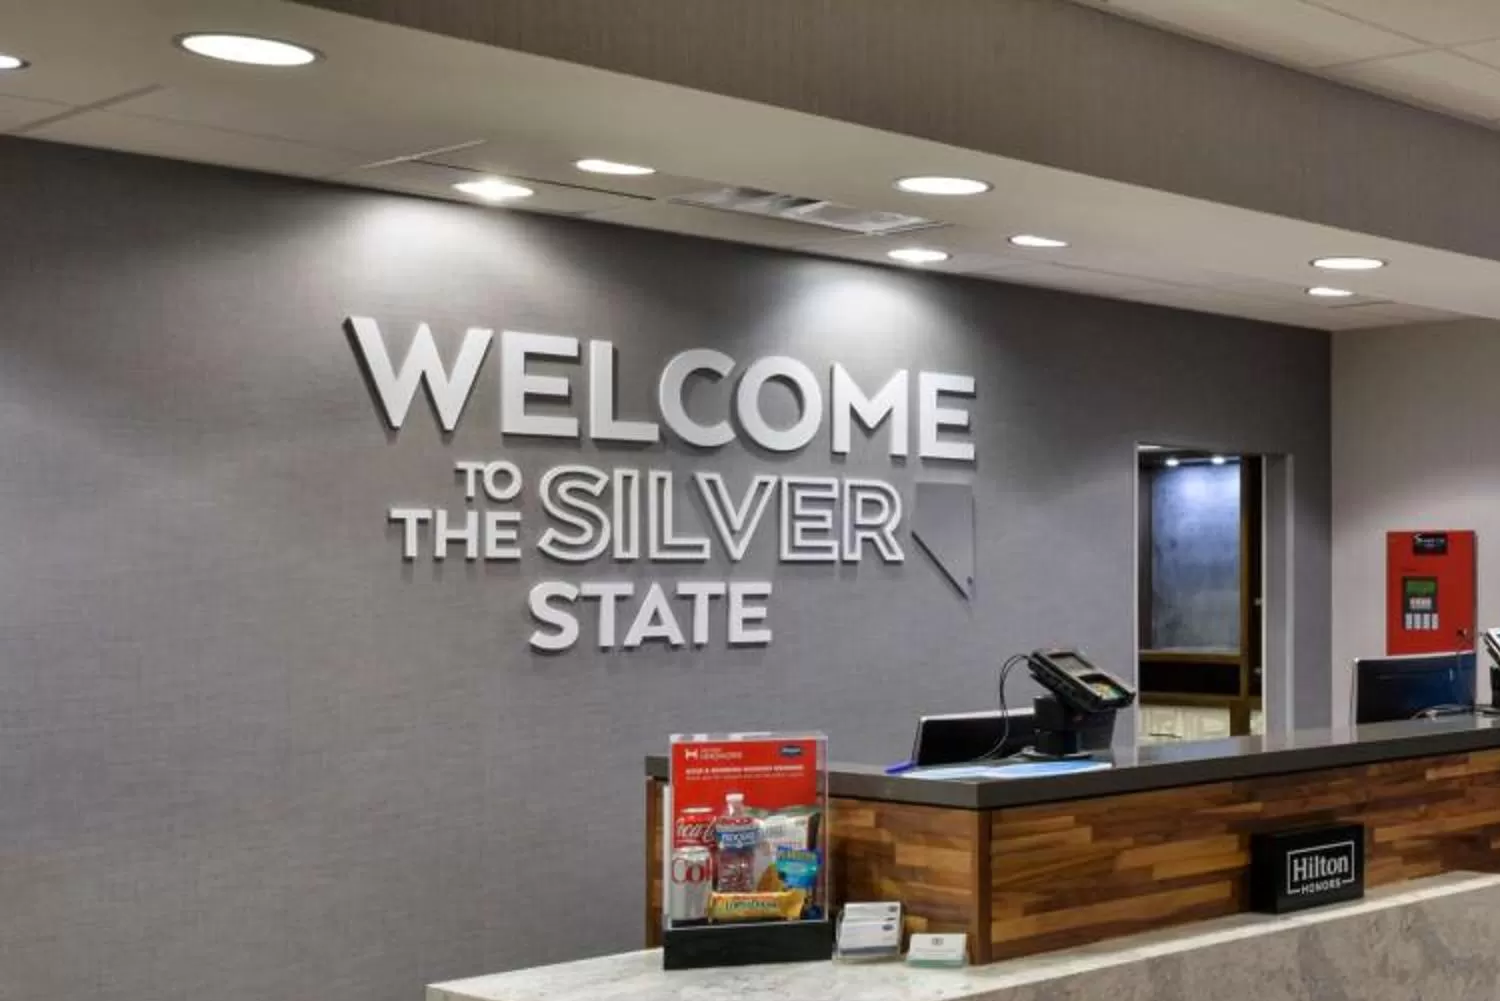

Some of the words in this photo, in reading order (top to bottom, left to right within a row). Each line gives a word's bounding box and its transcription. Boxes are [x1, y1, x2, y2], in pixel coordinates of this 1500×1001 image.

[344, 315, 976, 461] WELCOME
[455, 460, 523, 501] TO
[388, 507, 523, 560] THE
[537, 464, 905, 563] SILVER
[528, 580, 773, 652] STATE
[1292, 854, 1349, 883] Hilton
[1301, 878, 1341, 895] HONORS
